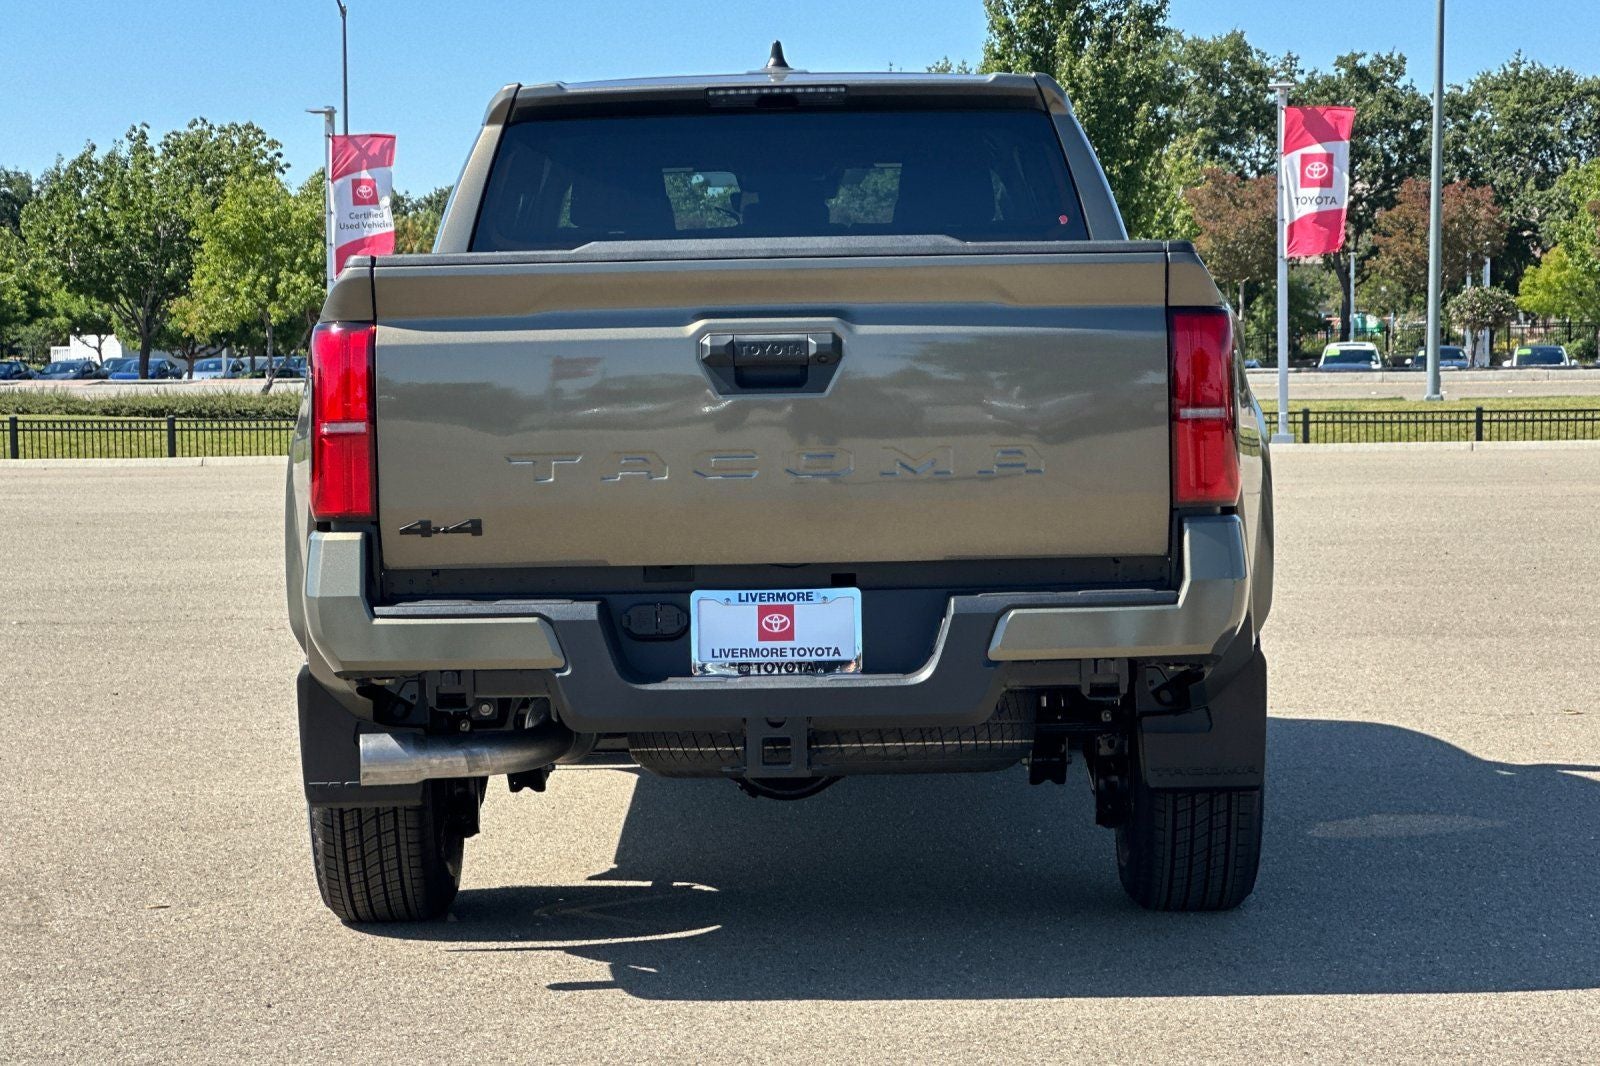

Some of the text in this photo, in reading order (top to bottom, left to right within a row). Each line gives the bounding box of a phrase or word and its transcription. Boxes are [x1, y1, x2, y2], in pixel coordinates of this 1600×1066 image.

[1294, 196, 1338, 206] TOYOTA
[348, 211, 384, 220] Certified
[339, 221, 393, 230] Used Vehicles
[741, 344, 805, 356] TOYOTA
[504, 443, 1045, 483] TACOMA
[737, 591, 814, 603] LIVERMORE
[711, 646, 842, 659] LIVERMORE TOYOTA
[755, 661, 815, 674] TOYOTA
